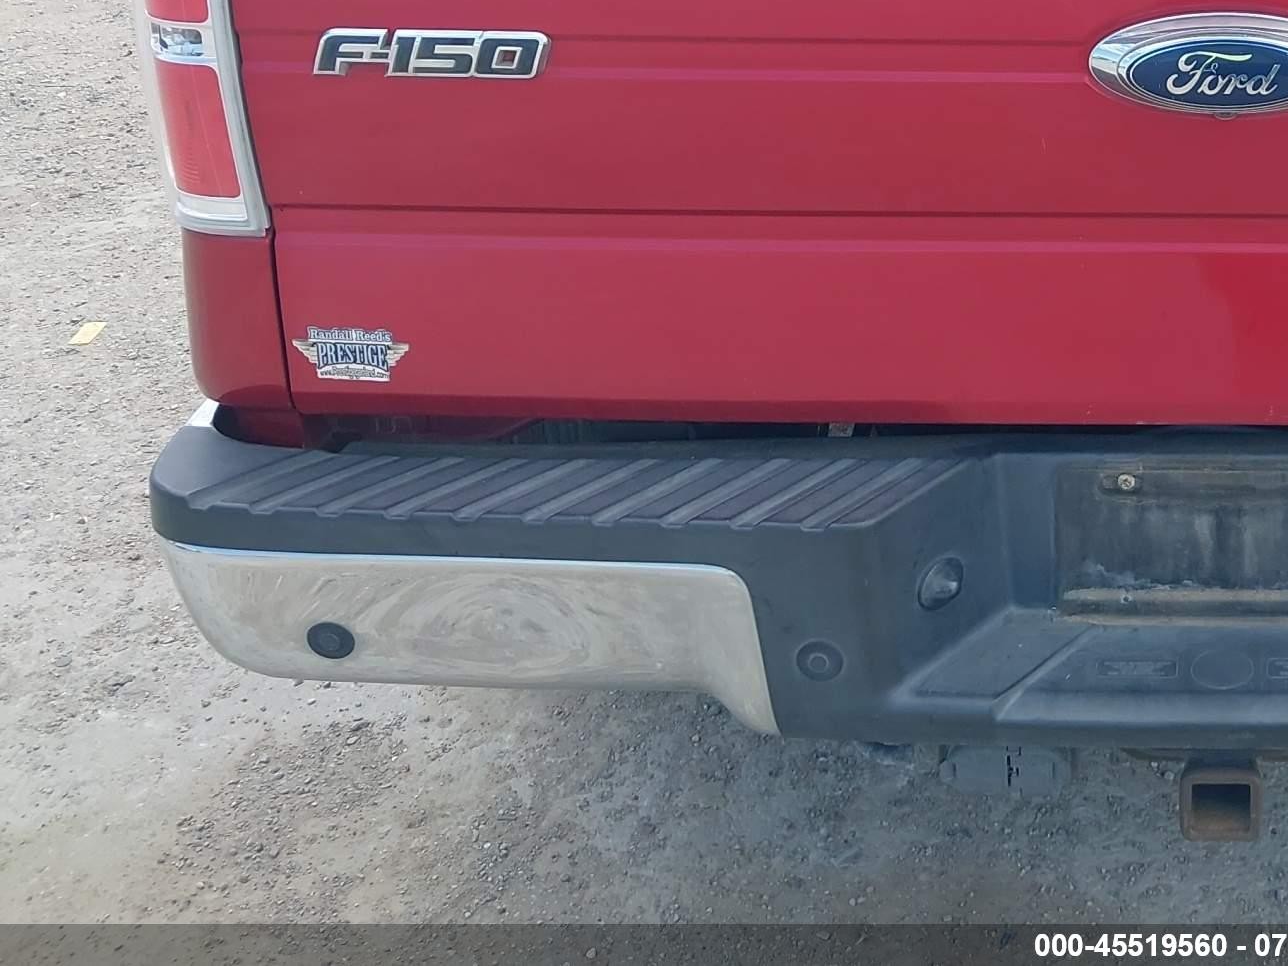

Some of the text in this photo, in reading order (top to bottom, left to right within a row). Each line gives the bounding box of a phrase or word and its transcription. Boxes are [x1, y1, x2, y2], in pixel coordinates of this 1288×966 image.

[313, 27, 550, 79] F-150
[1166, 51, 1281, 96] Ford
[310, 329, 391, 342] Randall Reed's
[318, 343, 388, 370] PRESTIGE
